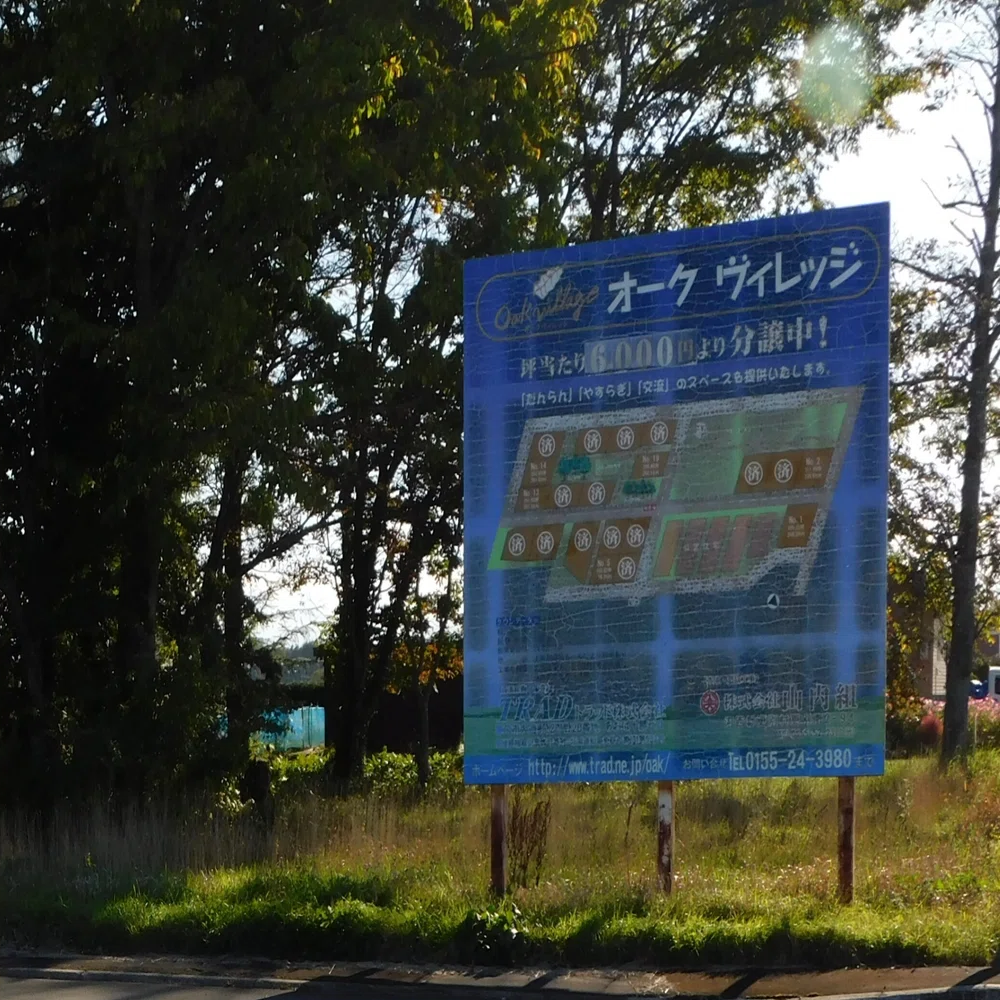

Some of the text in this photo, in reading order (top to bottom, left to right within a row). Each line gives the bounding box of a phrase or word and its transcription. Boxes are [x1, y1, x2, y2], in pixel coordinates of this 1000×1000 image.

[607, 241, 863, 313] オーク ヴィレッジ
